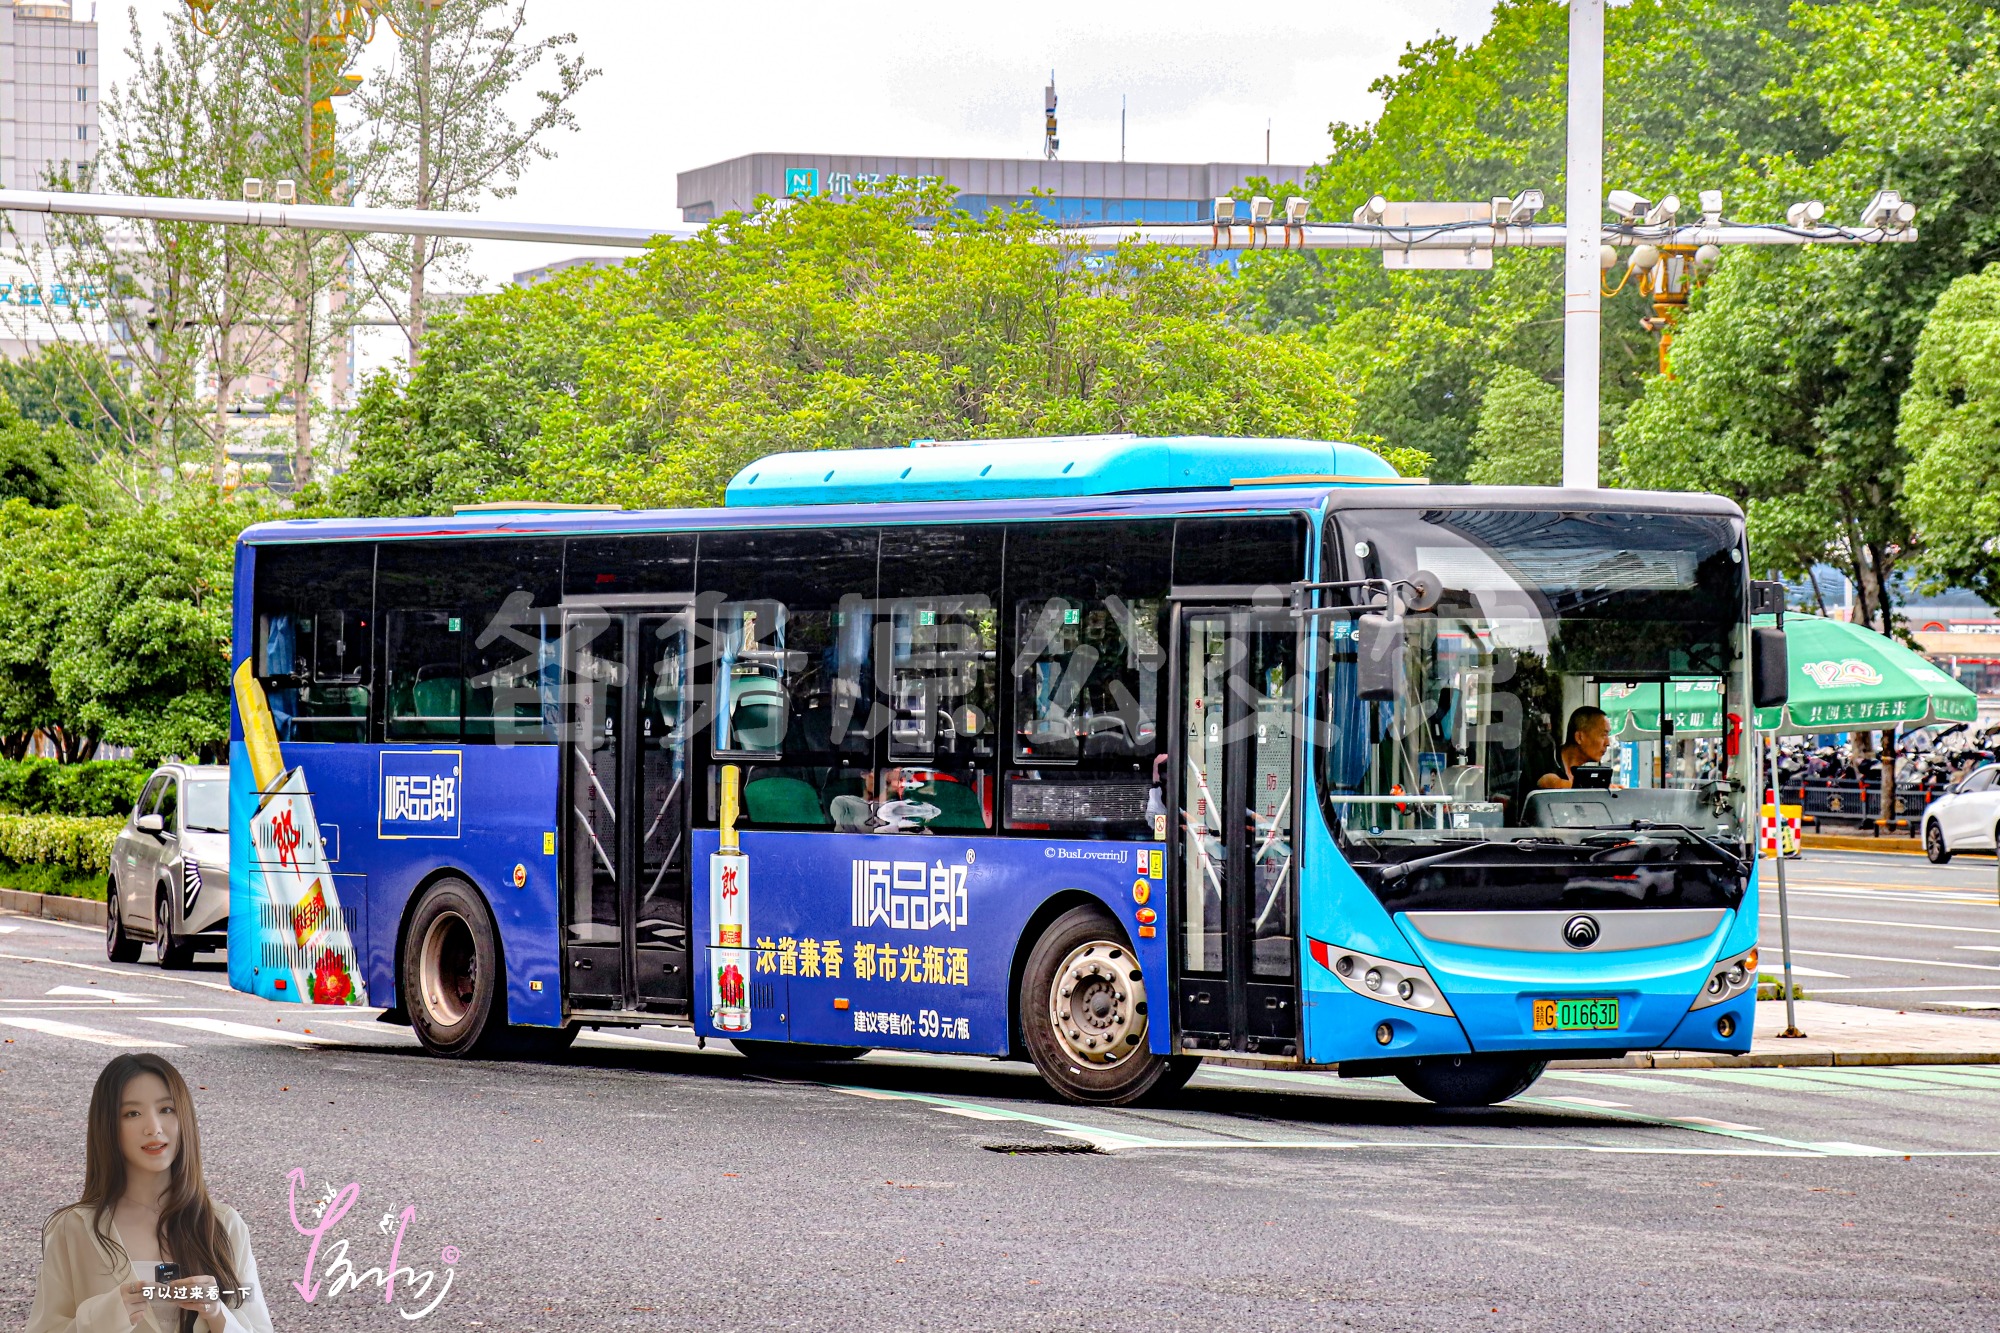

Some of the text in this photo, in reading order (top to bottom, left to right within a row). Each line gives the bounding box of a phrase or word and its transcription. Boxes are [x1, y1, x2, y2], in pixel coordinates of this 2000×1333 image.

[1810, 701, 1907, 722] 共创美好未来
[1197, 772, 1208, 870] 注意开门
[1265, 773, 1278, 873] 防止夹伤
[755, 936, 969, 987] 浓酱兼香 都市光瓶酒
